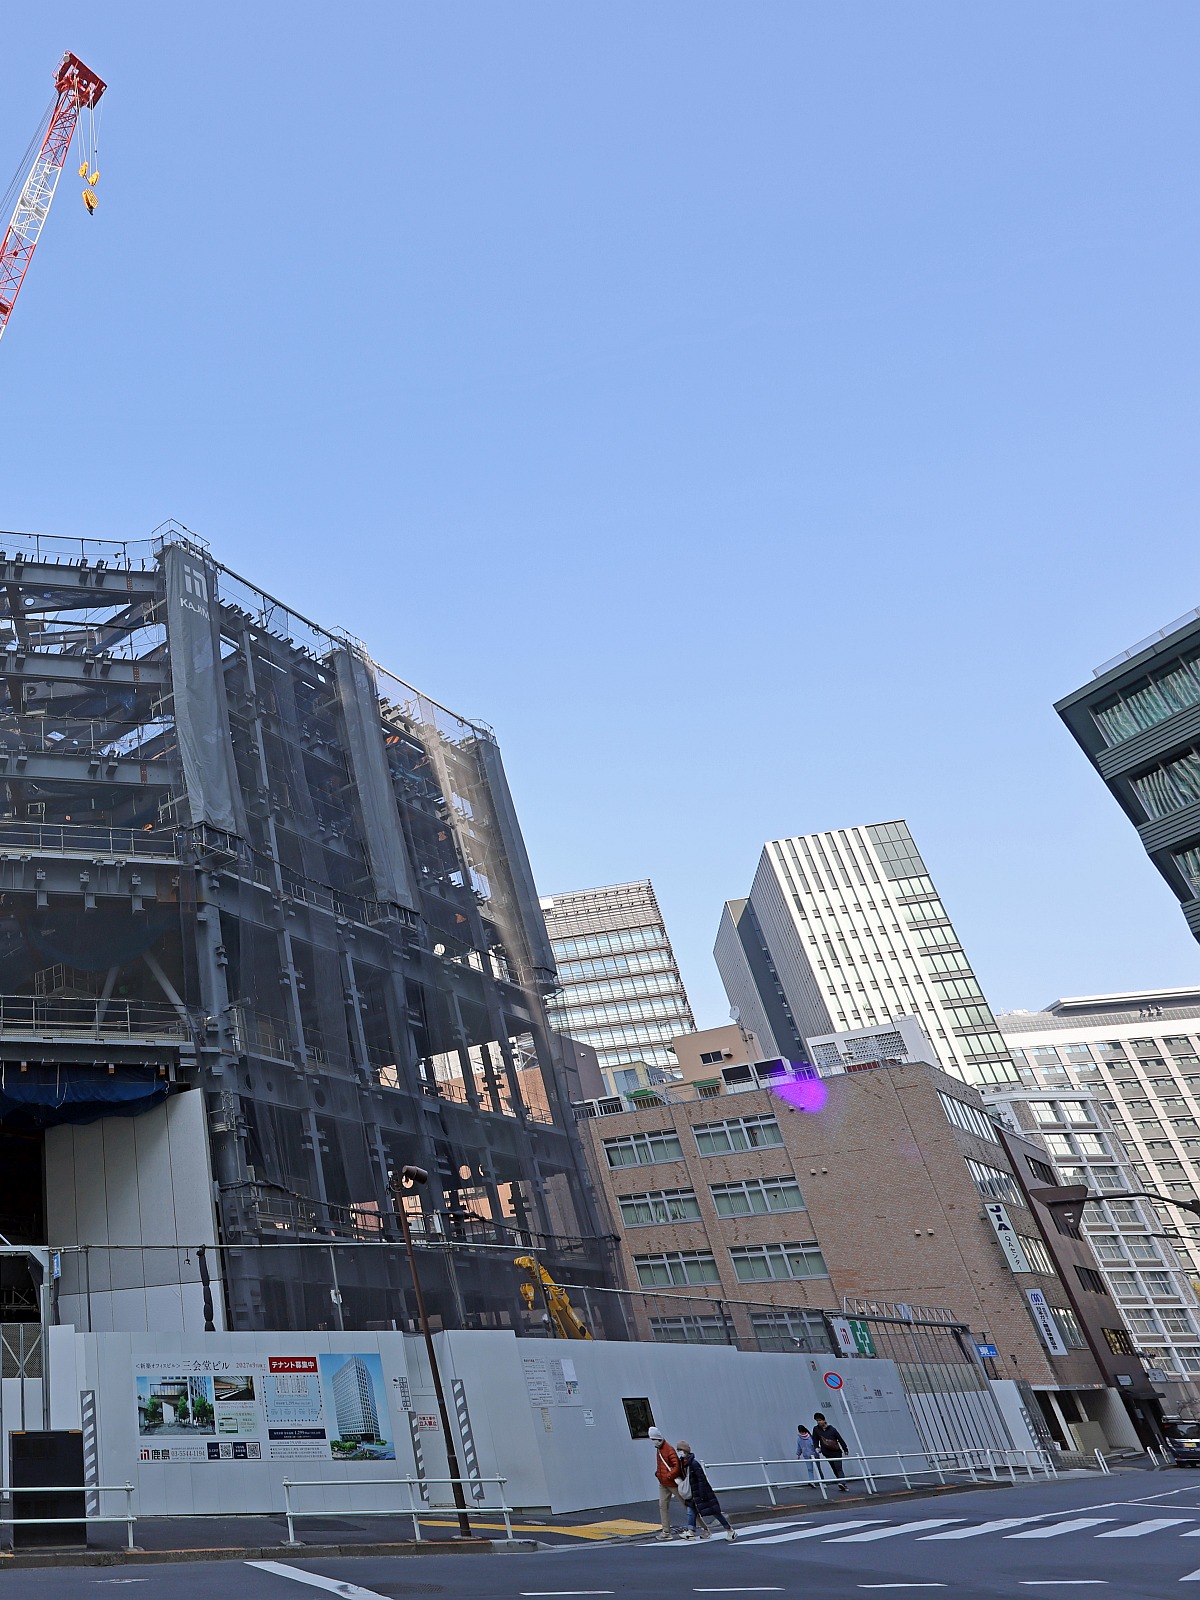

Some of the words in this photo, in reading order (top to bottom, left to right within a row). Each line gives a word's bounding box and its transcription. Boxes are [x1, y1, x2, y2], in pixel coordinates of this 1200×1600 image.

[182, 1360, 230, 1371] 三会堂ビル
[271, 1360, 315, 1369] テナント募集中
[151, 1449, 170, 1460] 鹿島
